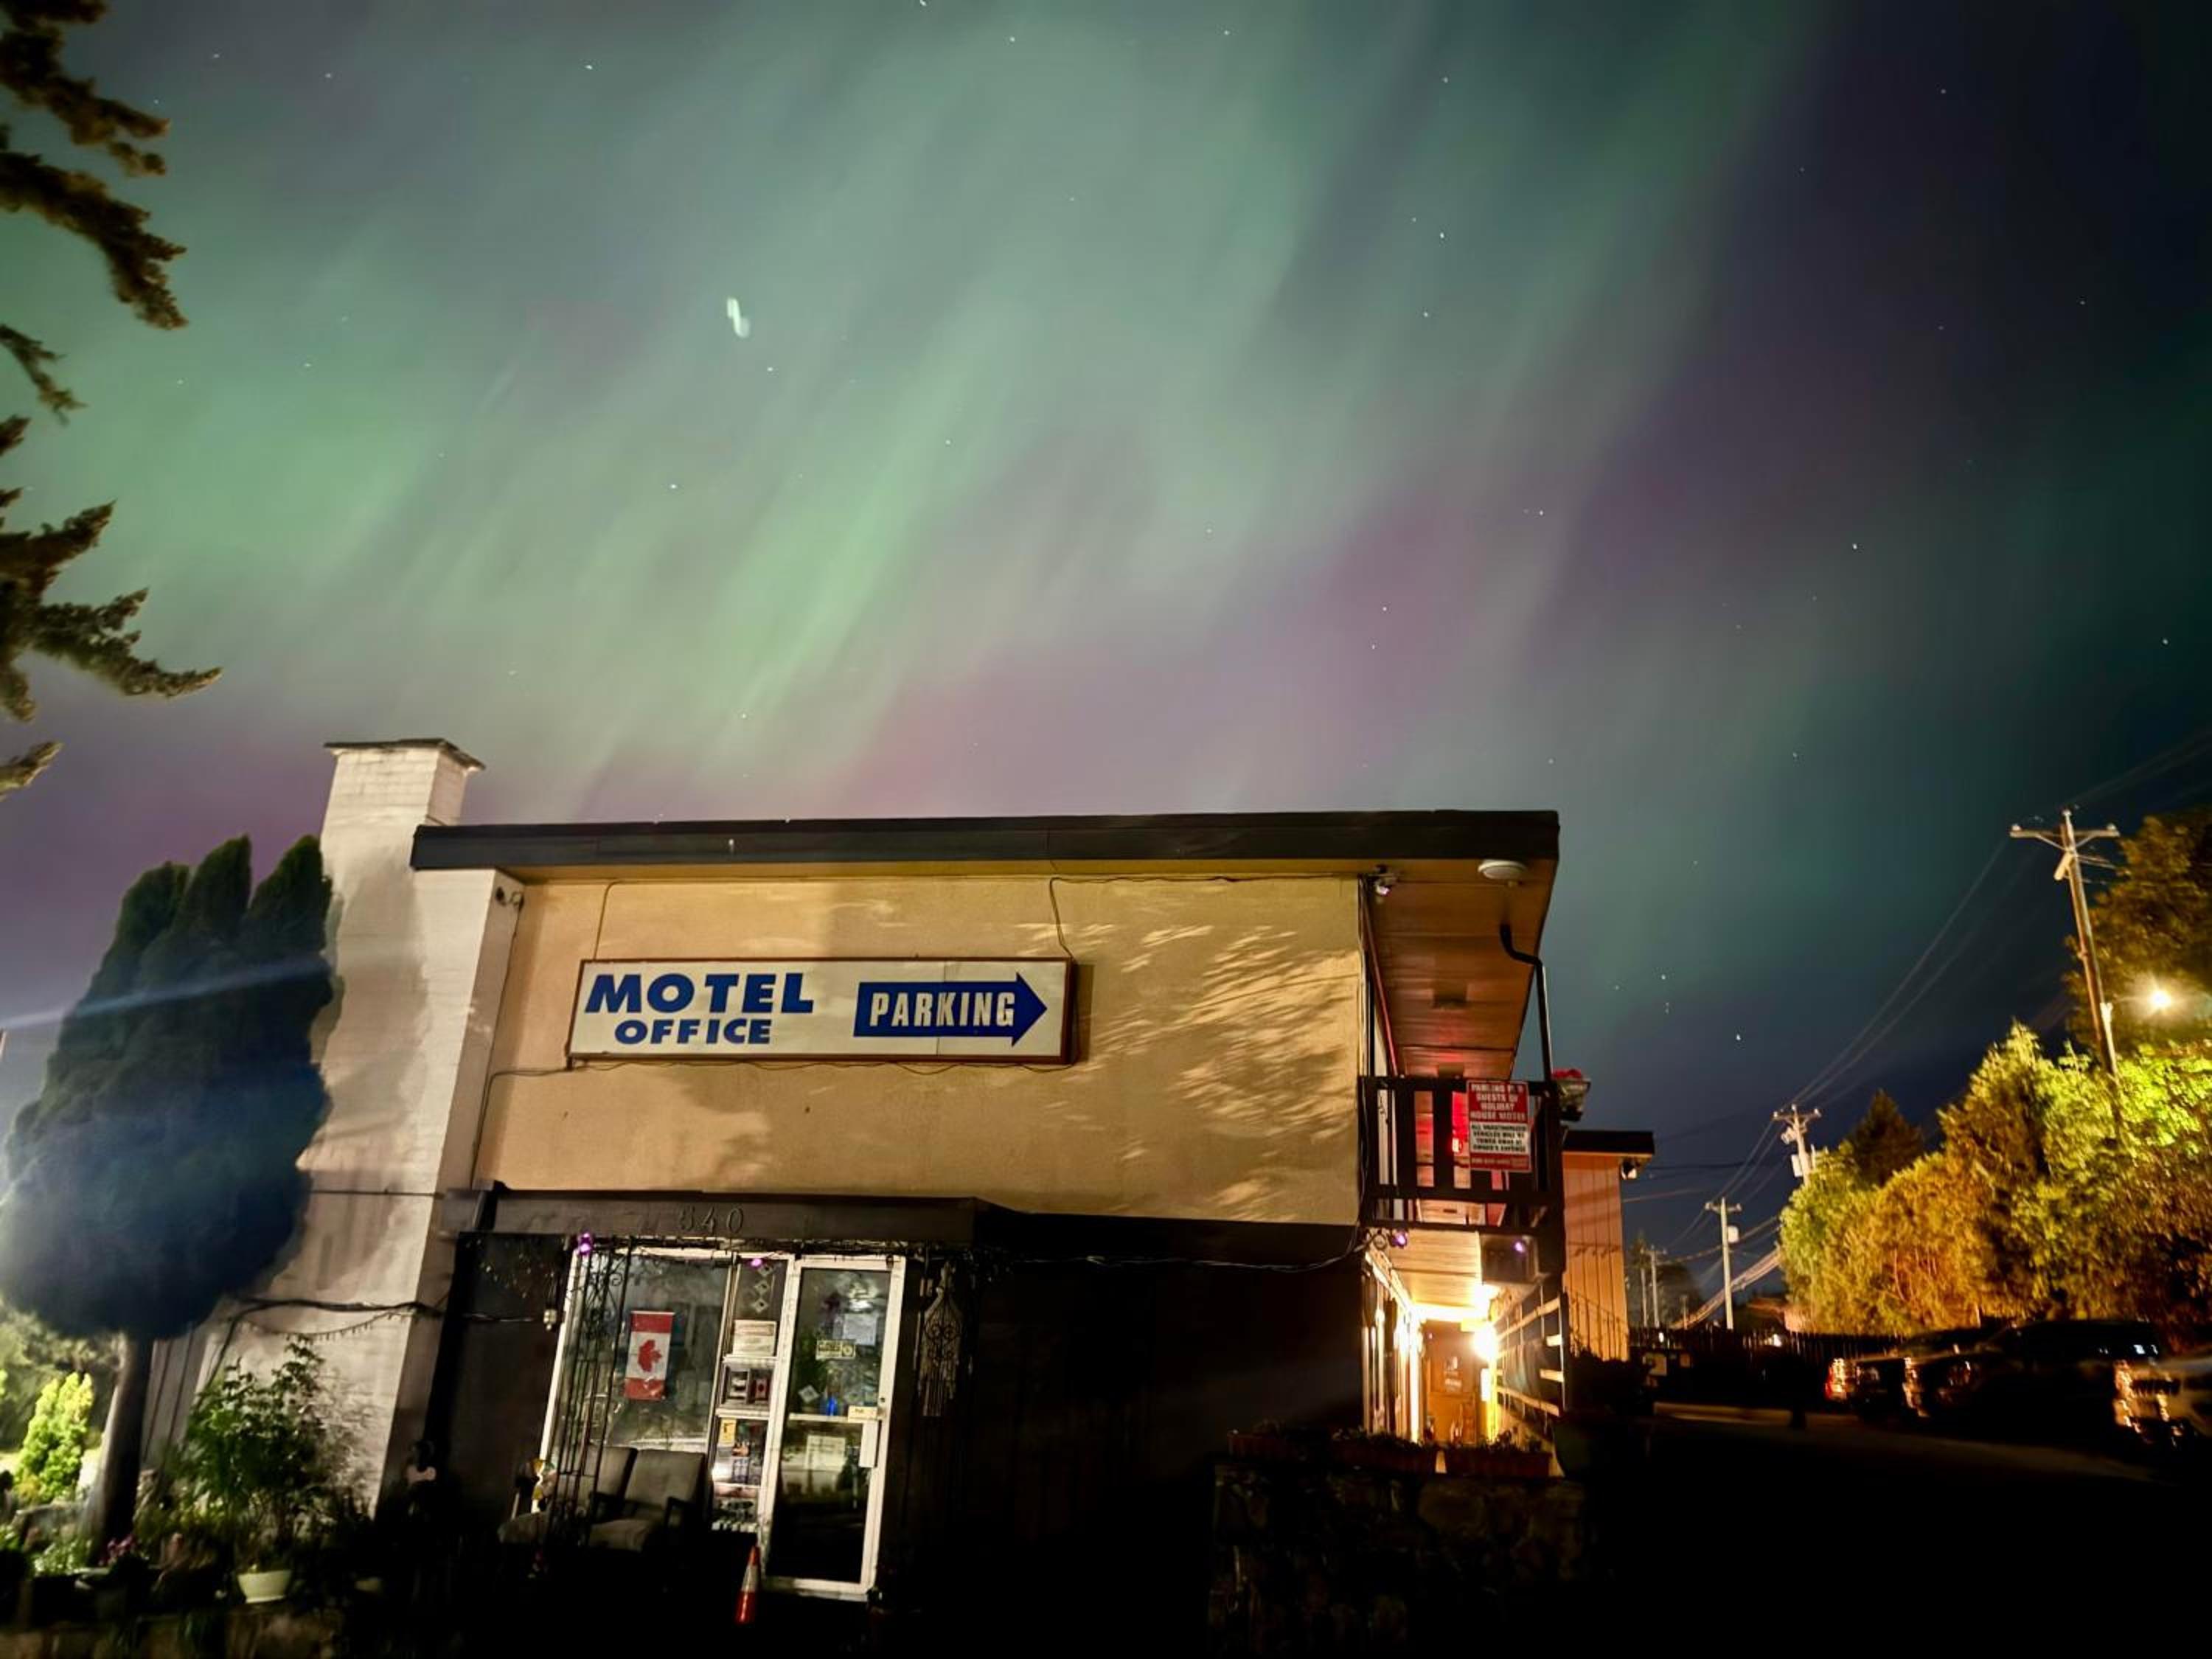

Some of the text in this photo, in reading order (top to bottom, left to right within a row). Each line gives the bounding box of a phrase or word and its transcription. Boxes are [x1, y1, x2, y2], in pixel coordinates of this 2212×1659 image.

[585, 973, 814, 1013] MOTEL
[869, 992, 1015, 1027] PARKING
[614, 1018, 772, 1044] OFFICE
